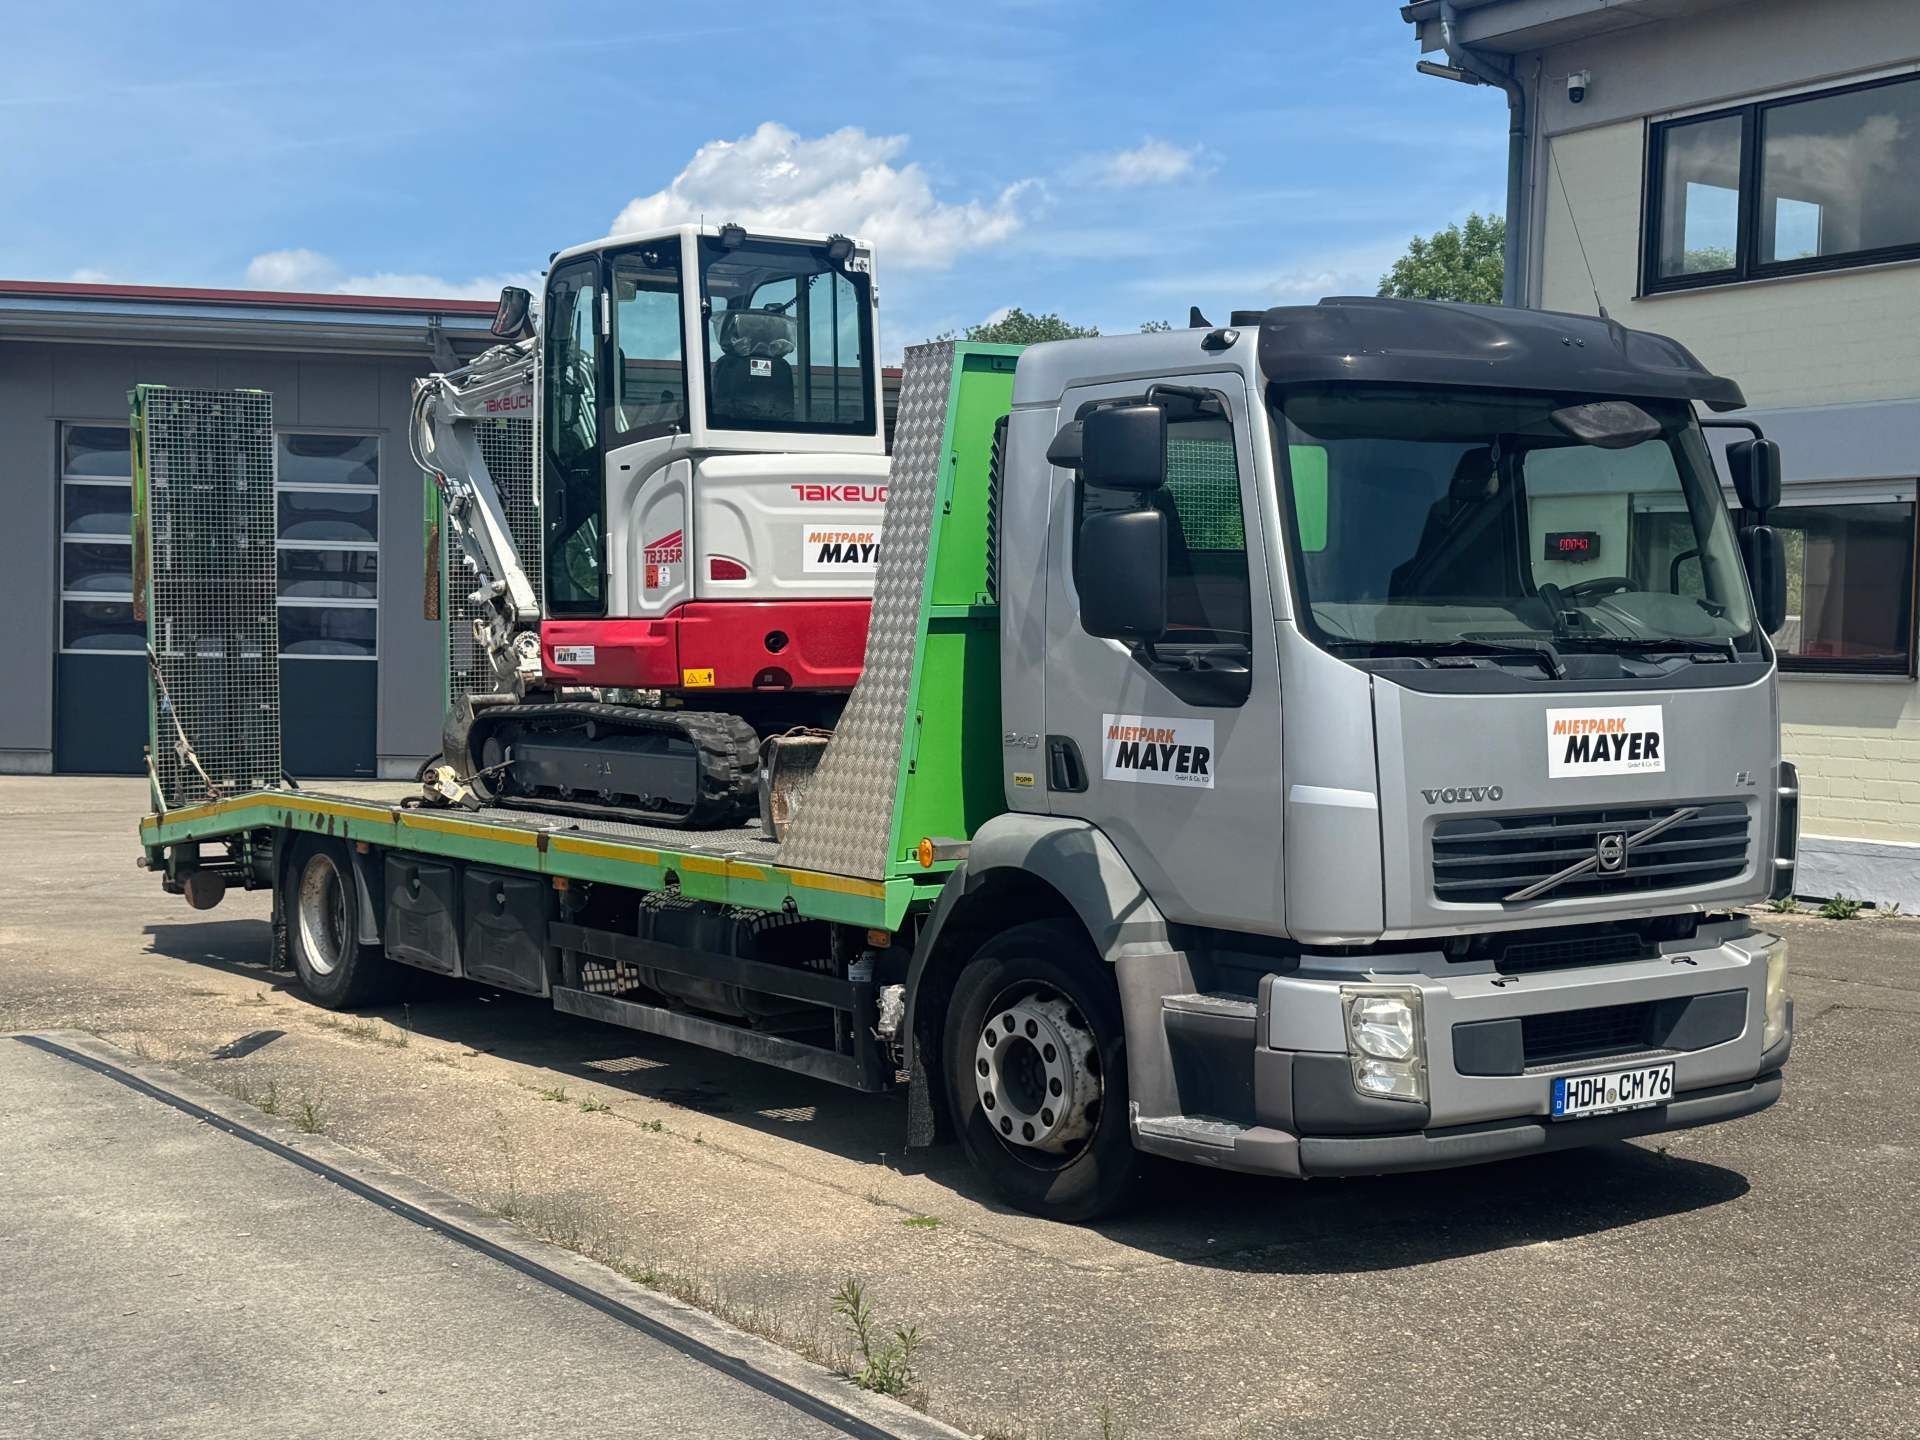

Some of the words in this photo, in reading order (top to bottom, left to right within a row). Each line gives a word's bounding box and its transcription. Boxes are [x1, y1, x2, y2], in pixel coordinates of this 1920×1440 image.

[808, 532, 874, 543] MIETPARK
[643, 549, 682, 564] TB335R
[557, 652, 577, 662] MAYER
[1107, 725, 1176, 743] MIETPARK
[1553, 718, 1627, 735] MIETPARK
[1564, 732, 1660, 763] MAYER
[1115, 741, 1210, 775] MAYER
[1420, 785, 1504, 805] VOLVO
[1566, 1077, 1606, 1110] HDH
[1619, 1072, 1645, 1101] CM
[1648, 1068, 1671, 1097] 76
[1556, 1100, 1562, 1109] D
